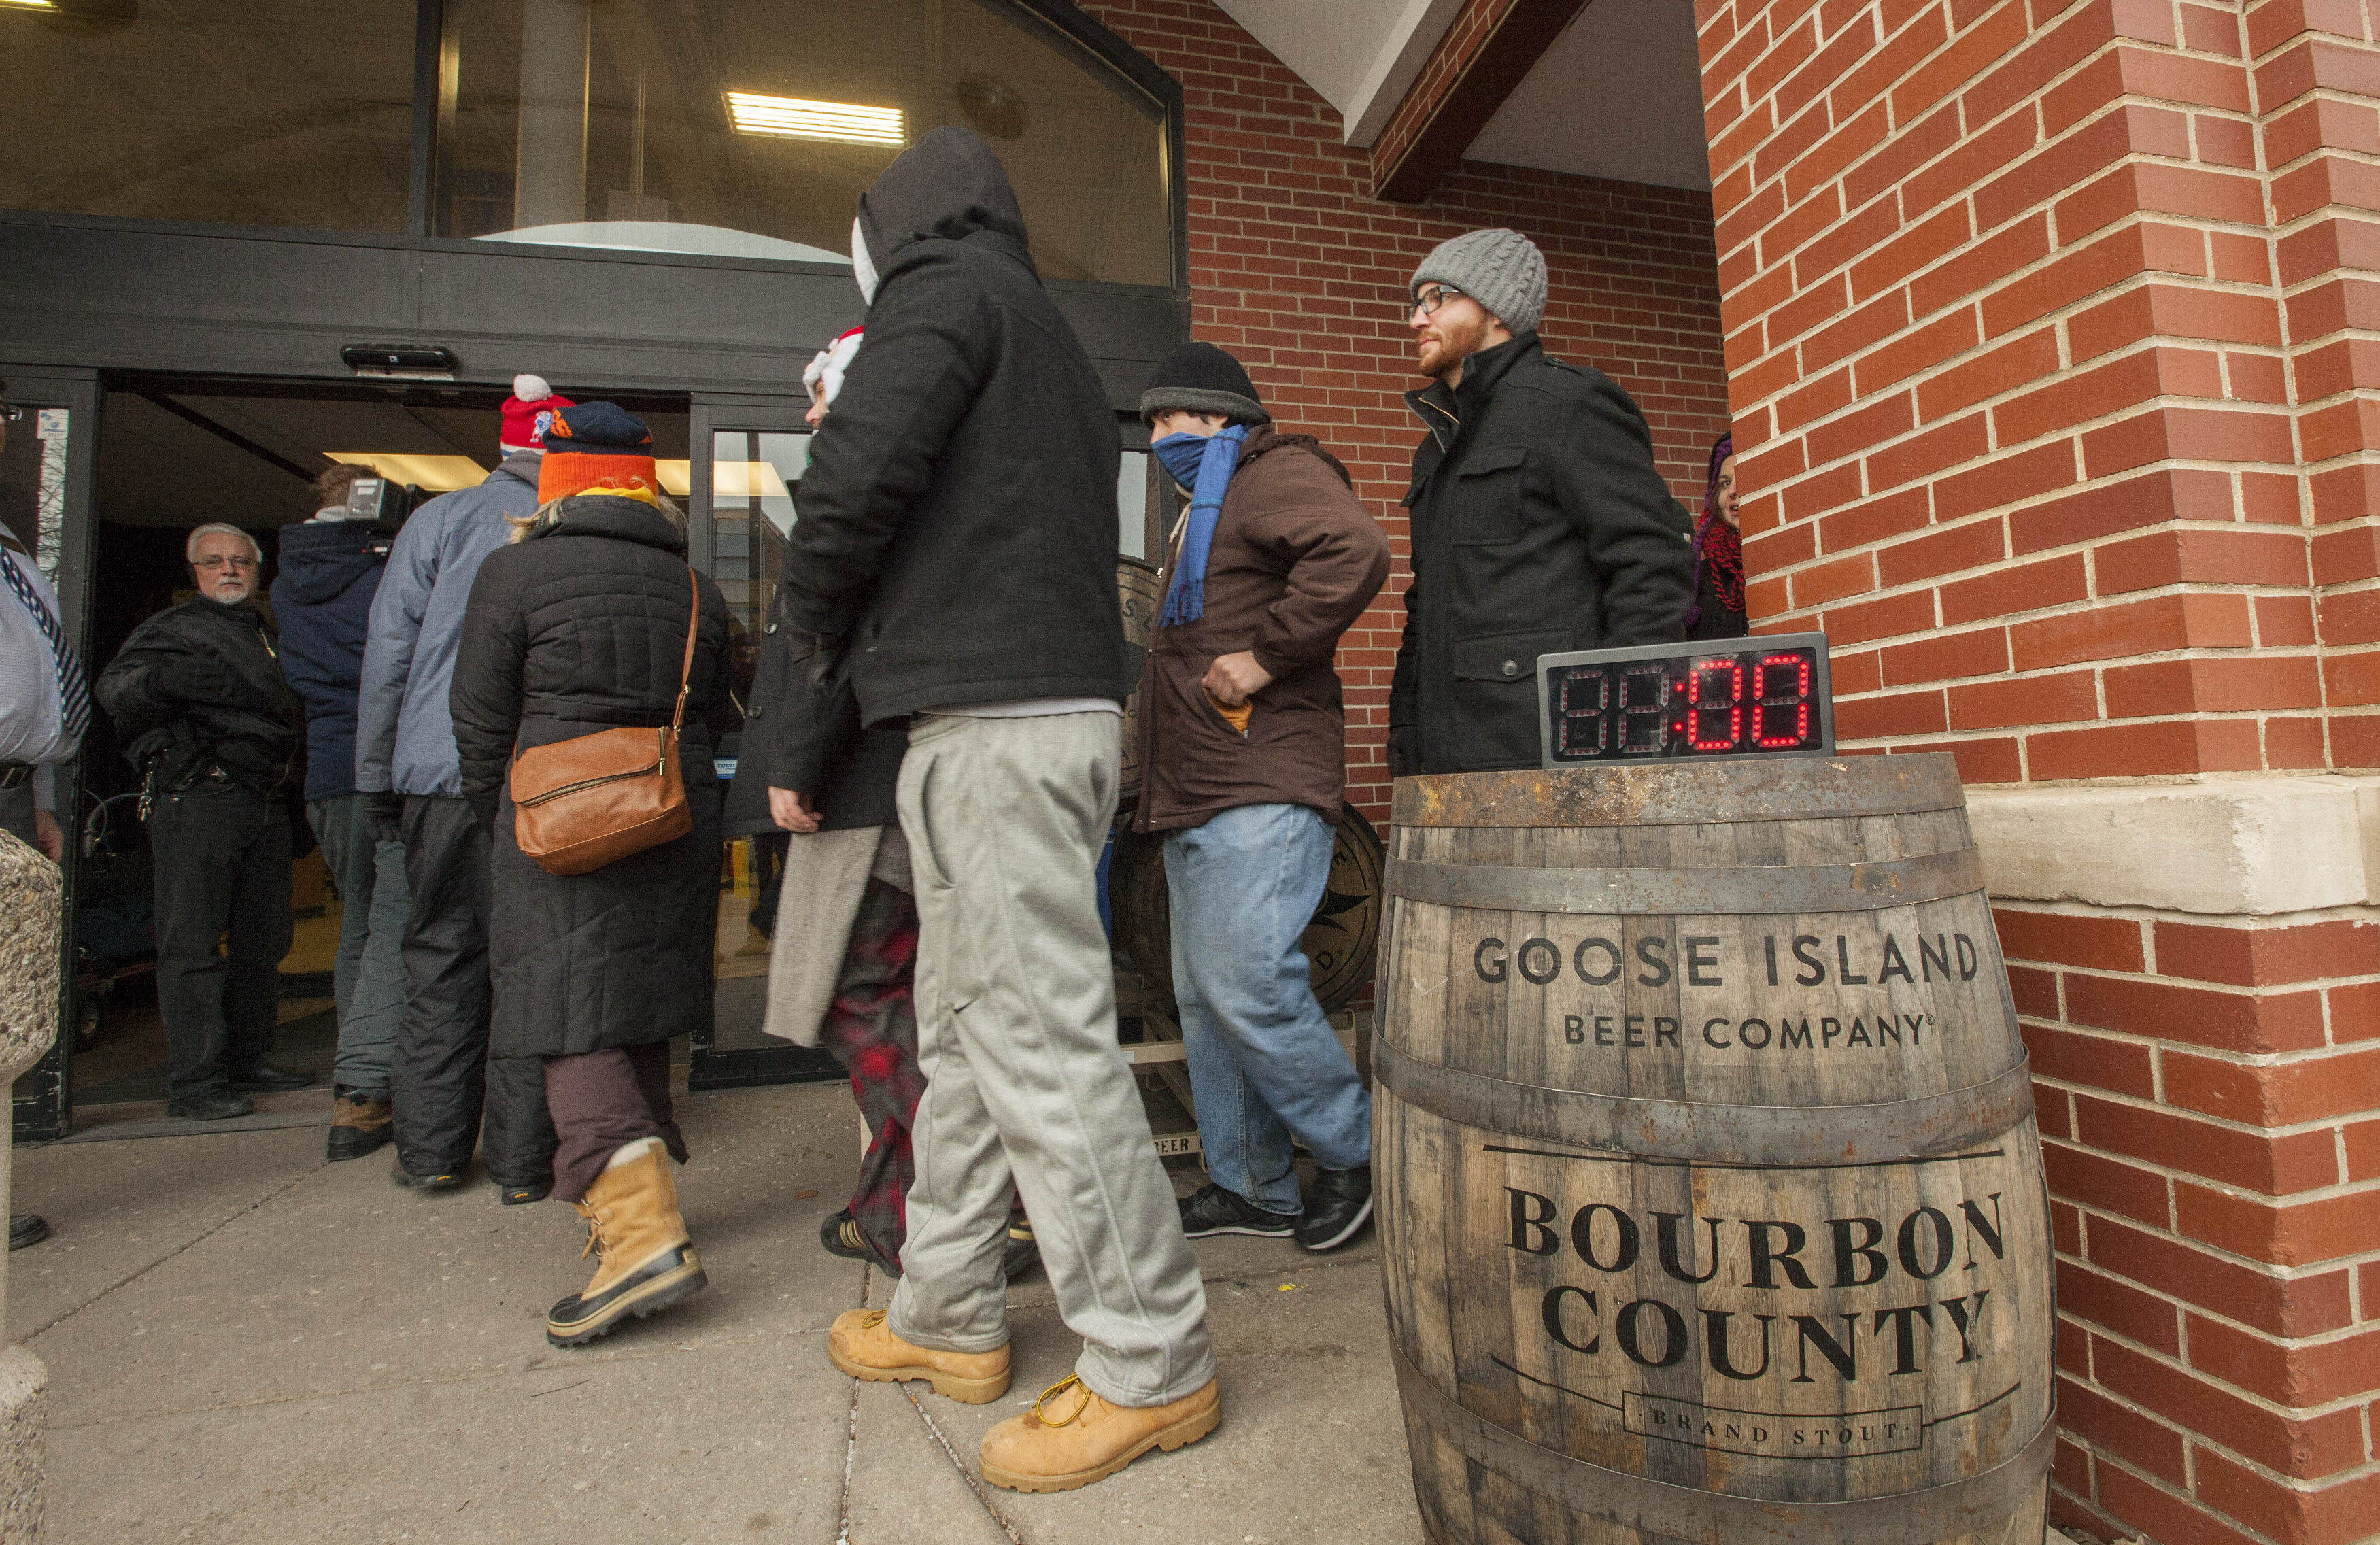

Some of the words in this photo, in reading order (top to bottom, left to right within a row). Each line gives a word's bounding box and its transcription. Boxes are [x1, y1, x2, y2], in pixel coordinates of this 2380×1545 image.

[1474, 936, 1723, 987] GOOSE
[1764, 933, 1977, 987] ISLAND
[1564, 1015, 1680, 1048] BEER
[1503, 1185, 2005, 1290] BOURBON
[1541, 1284, 1994, 1383] COUNTY
[1652, 1409, 1768, 1443] BRAND
[1792, 1423, 1897, 1445] STOUT
